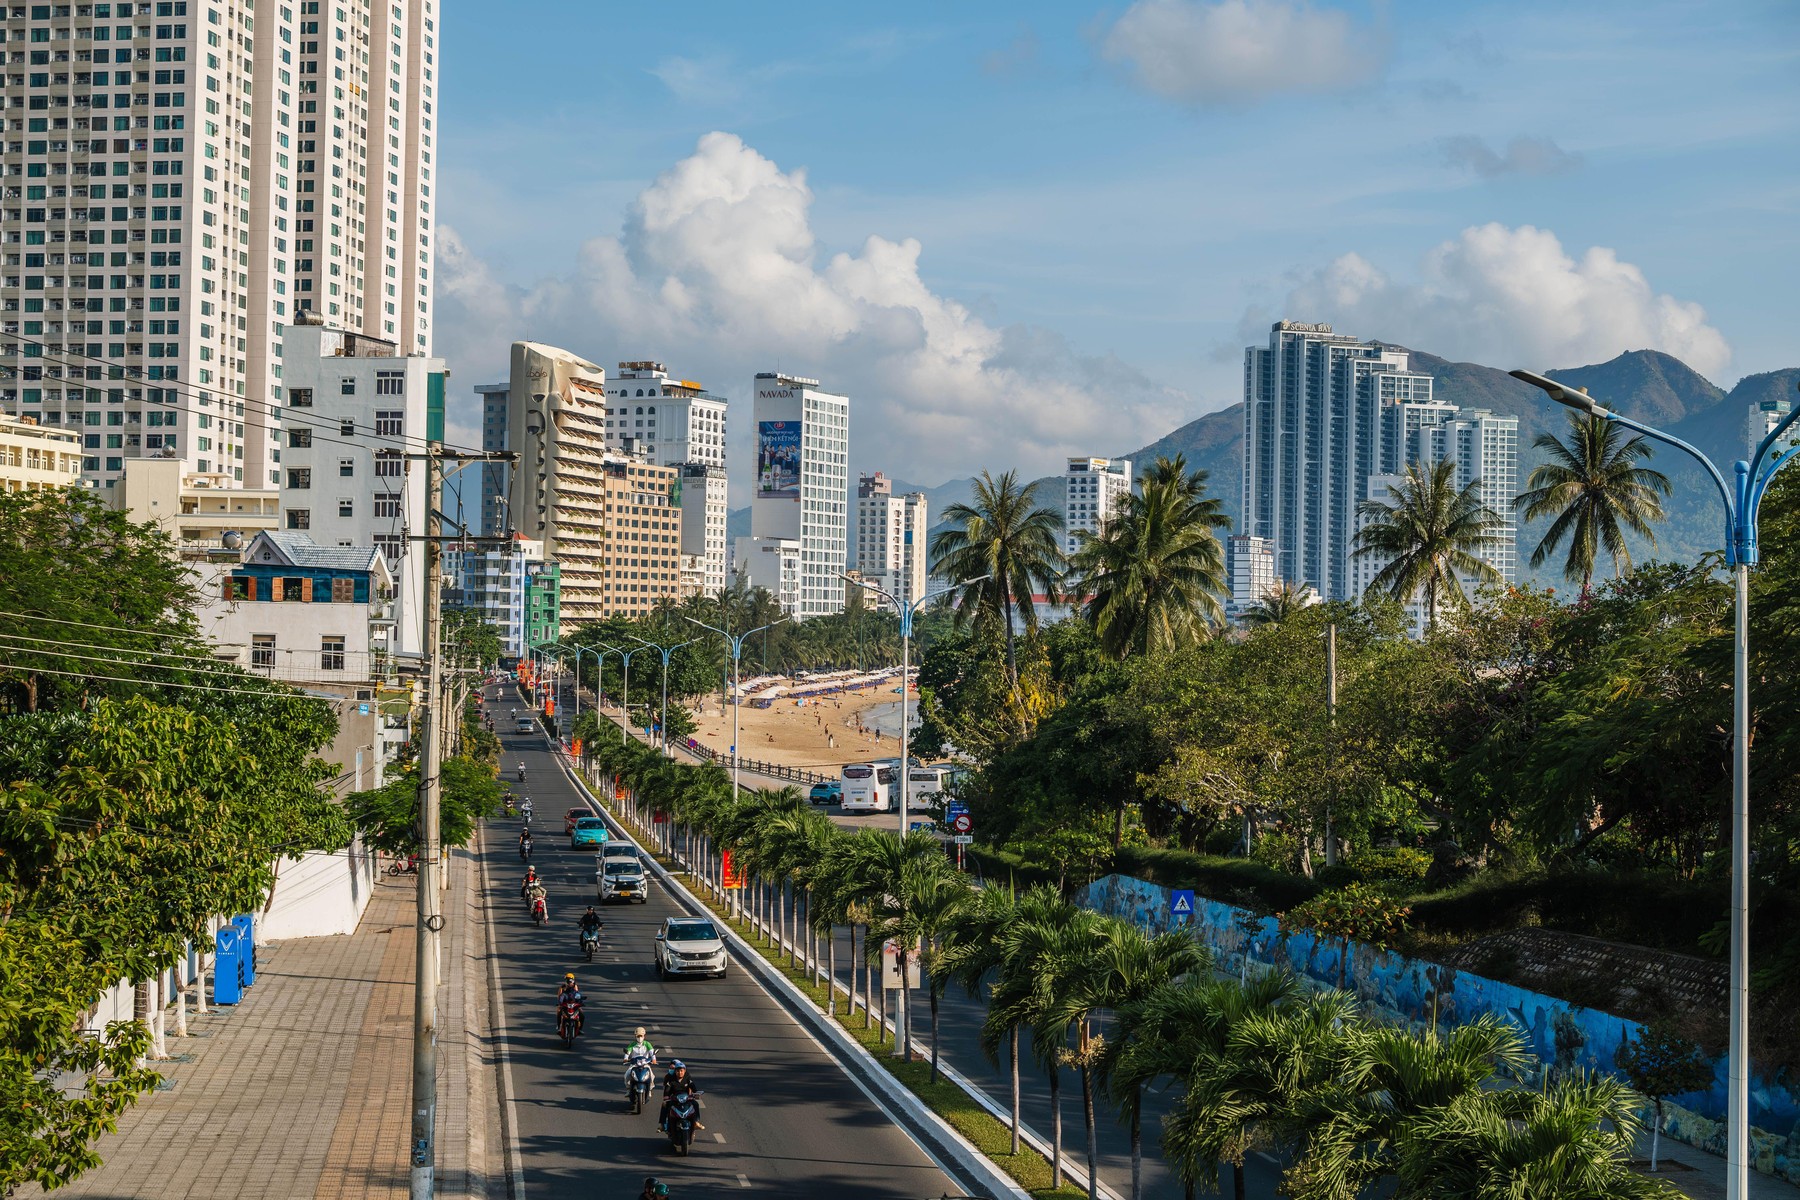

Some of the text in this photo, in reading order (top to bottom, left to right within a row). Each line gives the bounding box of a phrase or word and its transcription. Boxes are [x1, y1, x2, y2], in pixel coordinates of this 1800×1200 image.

[1290, 323, 1332, 333] SCENIA BAY
[760, 390, 794, 398] NAVADA
